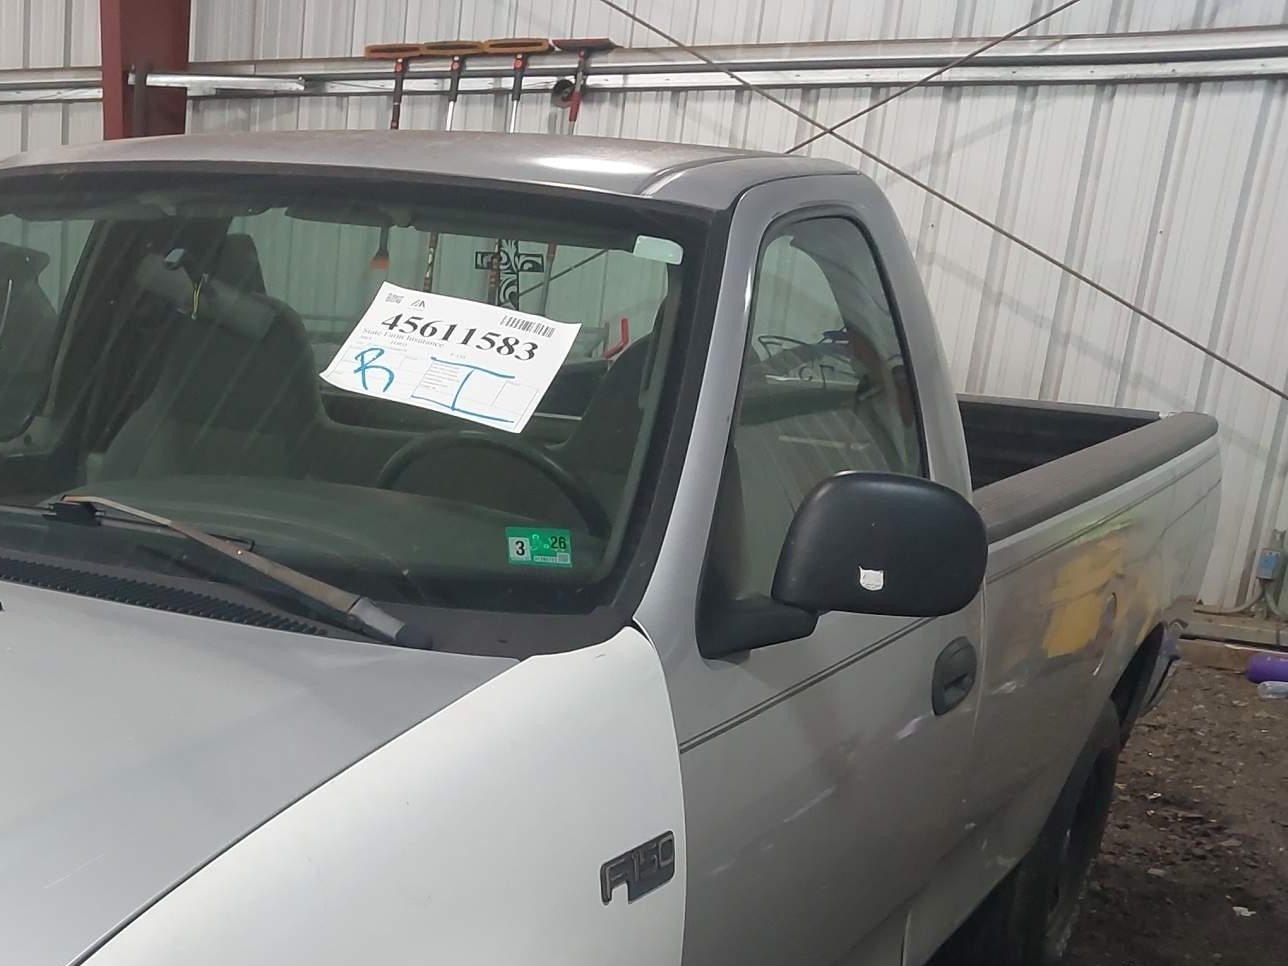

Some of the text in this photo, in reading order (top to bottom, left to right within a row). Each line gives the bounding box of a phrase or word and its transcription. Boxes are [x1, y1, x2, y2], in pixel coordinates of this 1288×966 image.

[381, 313, 539, 361] 45611583
[515, 540, 525, 556] 3
[550, 535, 567, 549] 26
